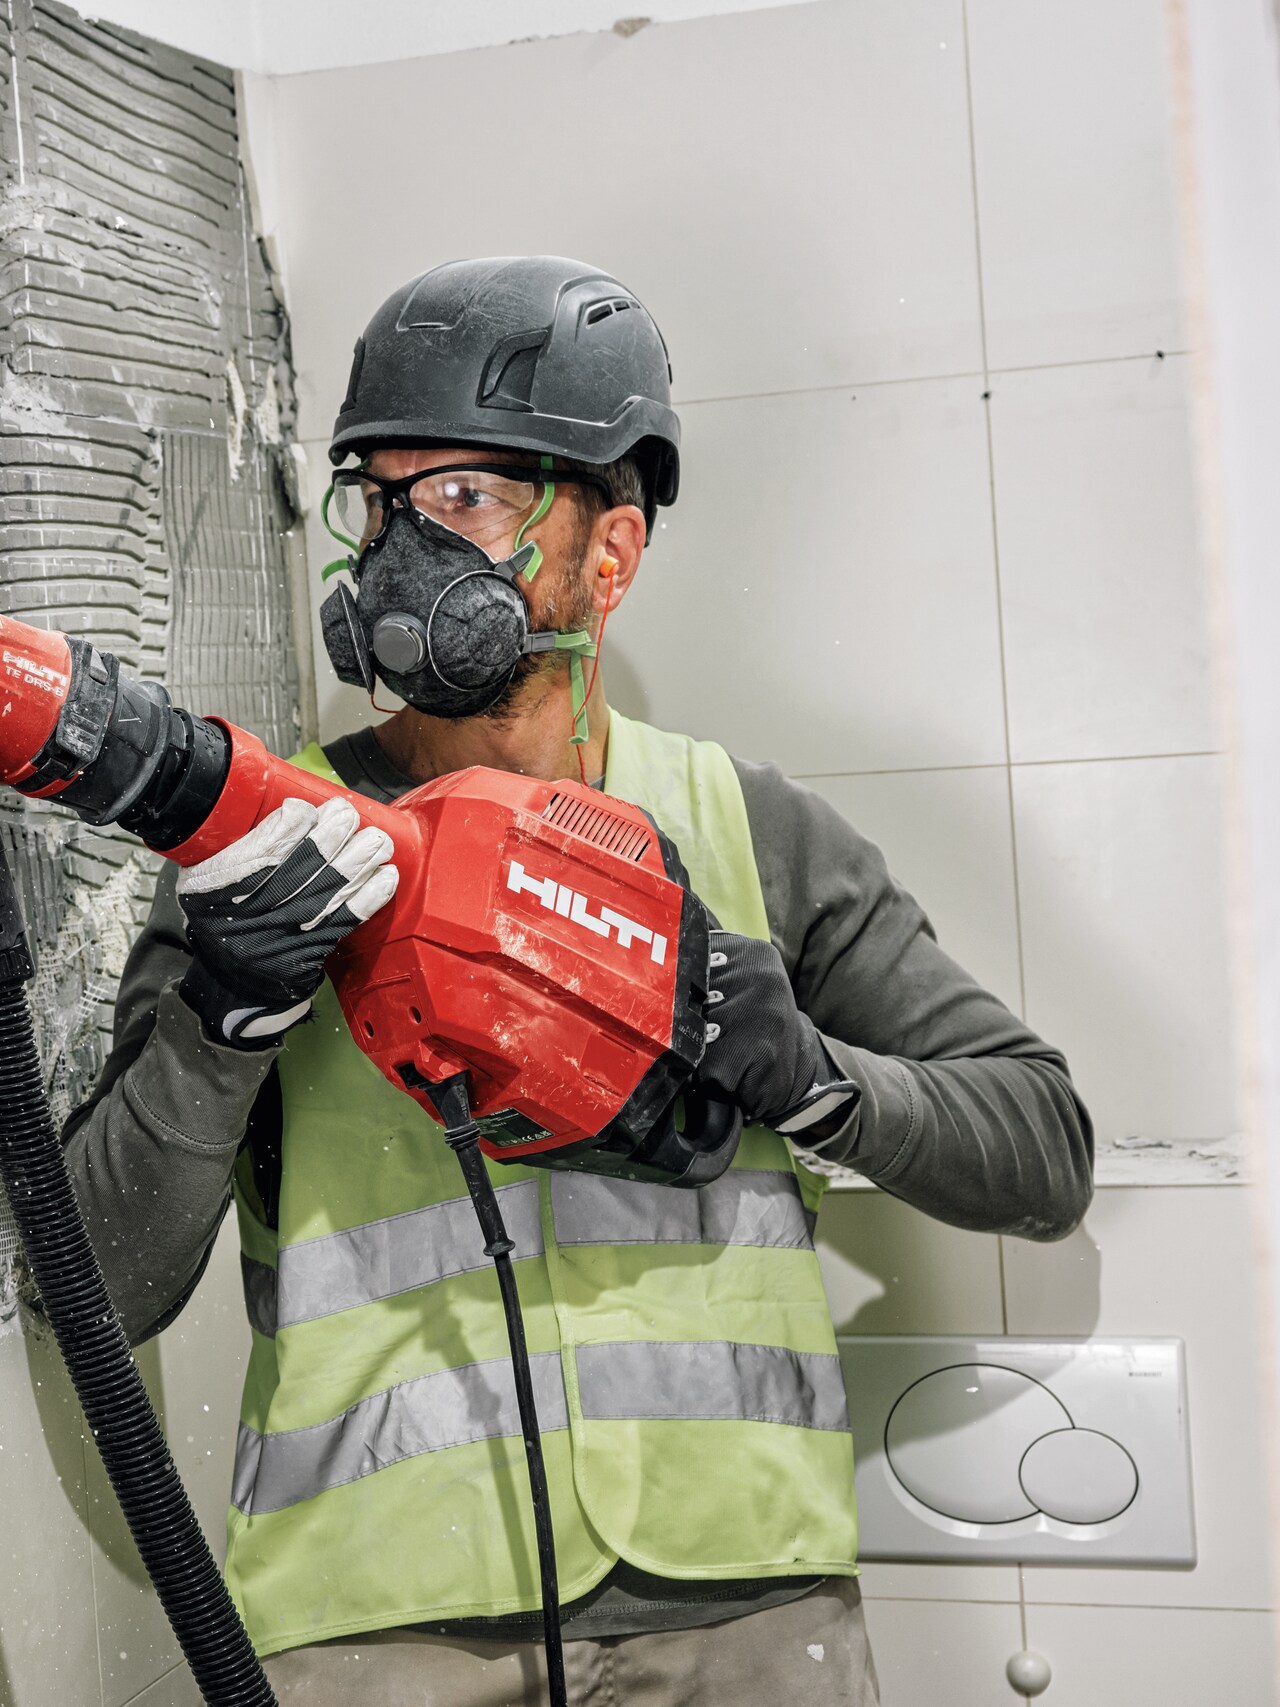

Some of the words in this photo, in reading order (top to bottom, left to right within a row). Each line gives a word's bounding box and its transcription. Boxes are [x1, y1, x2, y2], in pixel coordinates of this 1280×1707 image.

[2, 650, 67, 687] HILTI
[5, 665, 22, 679] TE
[24, 673, 64, 697] DRS-B
[507, 860, 668, 966] HILTI
